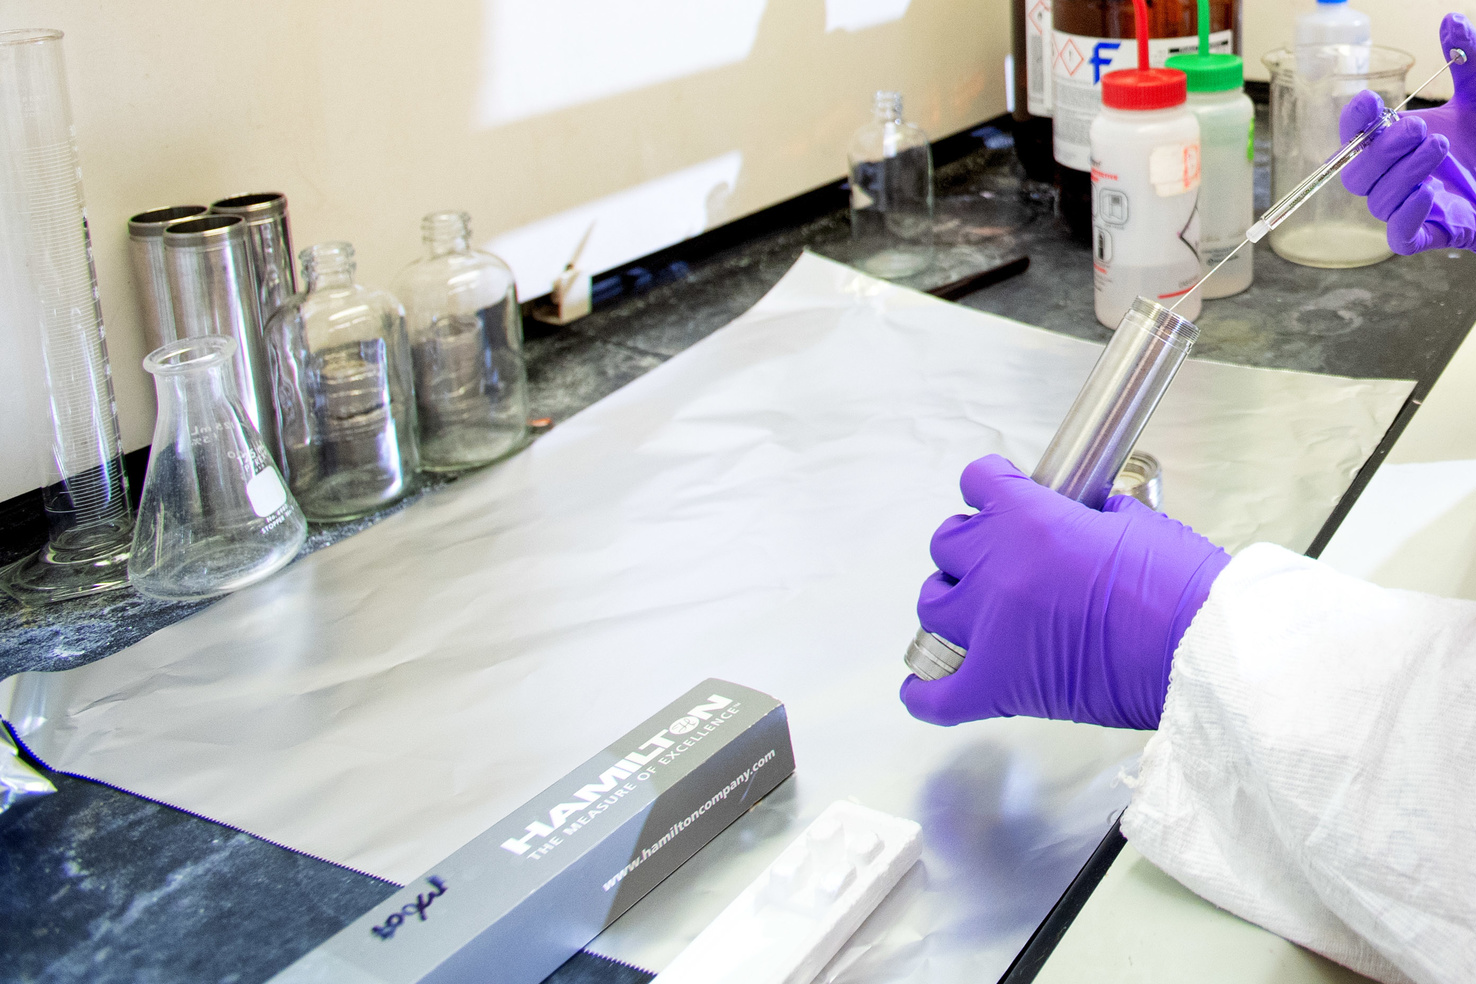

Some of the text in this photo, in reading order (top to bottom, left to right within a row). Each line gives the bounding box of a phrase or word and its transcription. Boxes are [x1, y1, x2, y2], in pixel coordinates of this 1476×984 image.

[500, 694, 733, 856] HAMILTON
[526, 835, 564, 860] THE
[562, 782, 637, 836] MEASURE
[637, 765, 656, 781] OF
[602, 749, 776, 892] www.hamiltoncompany.com
